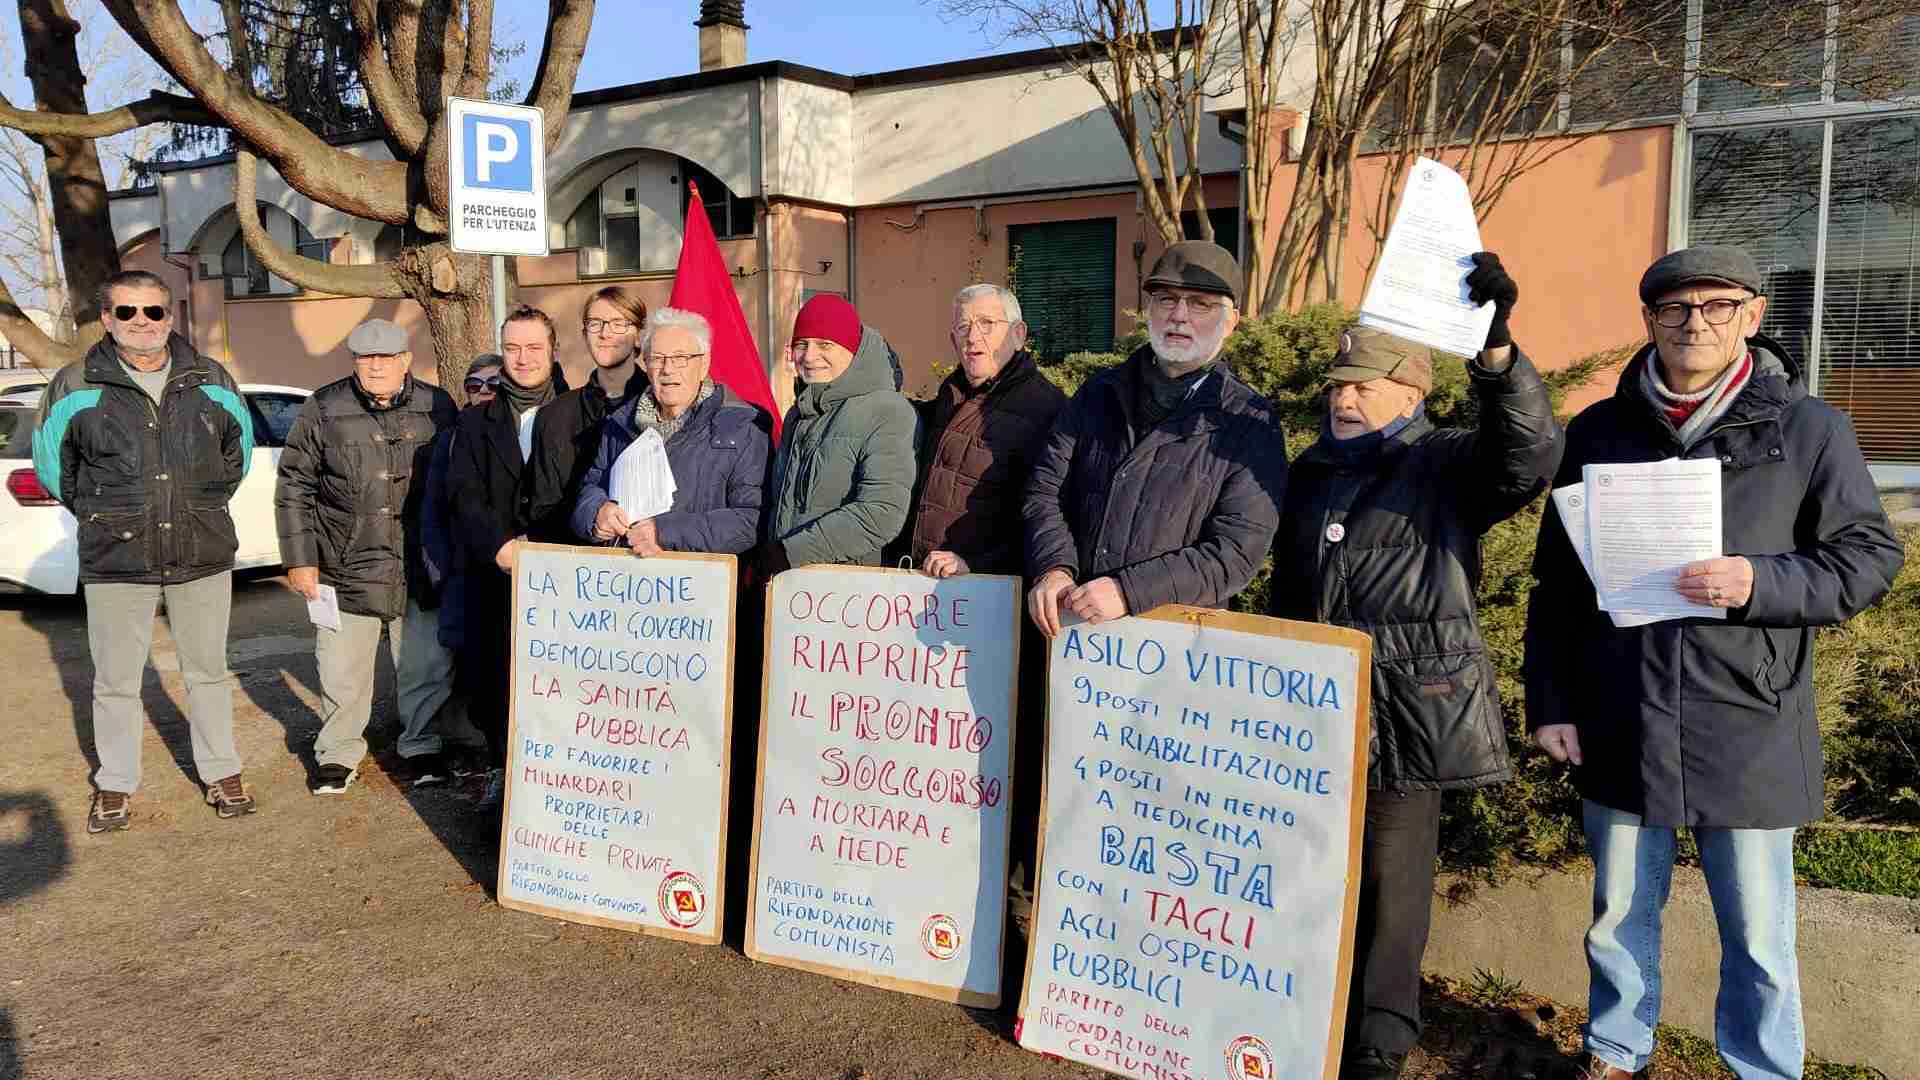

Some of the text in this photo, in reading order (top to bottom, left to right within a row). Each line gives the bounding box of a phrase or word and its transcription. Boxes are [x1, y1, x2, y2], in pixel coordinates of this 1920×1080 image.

[476, 121, 518, 182] P
[463, 204, 537, 218] PARCHEGGIO
[463, 217, 537, 231] PER L'UTENZA
[528, 566, 696, 605] LA REGIONE
[526, 607, 713, 643] E I VARI GOVERNI
[789, 590, 969, 632] OCCORRE
[529, 639, 707, 682] DEMOLISCONO
[793, 635, 976, 689] RIAPRIRE
[1063, 629, 1341, 709] ASILO VITTORIA
[531, 674, 677, 715] LA SANITÀ
[1074, 675, 1314, 752] 9 POSTI IN MENO
[575, 711, 690, 751] PUBBLICA
[791, 690, 993, 754] IL PRONTO
[524, 739, 554, 760] PER
[567, 747, 652, 775] FAVORIRE
[821, 746, 1001, 809] SOCCORSO
[1093, 721, 1332, 796] A RIABILITAZIONE
[523, 766, 633, 801] MILIARDARI
[1074, 756, 1296, 827] 4 POSTI IN MENO
[544, 795, 650, 826] PROPRIETARI
[563, 820, 609, 840] DELLE
[778, 795, 952, 844] A MORTARA E
[1096, 789, 1263, 851] A MEDICINA
[513, 826, 672, 874] CLINICHE PRIVATE
[810, 834, 910, 870] A MEDE
[1100, 825, 1274, 909] BASTA
[511, 874, 588, 905] RIFONDAZIONE
[767, 876, 873, 908] PARTITO DELLA
[1057, 869, 1255, 951] CON I TAGLI
[768, 897, 896, 936] RIFONDAZIONE
[773, 922, 896, 966] COMUNISTA
[1060, 907, 1293, 997] AGLI OSPEDALI
[1052, 942, 1182, 1008] PUBBLICI
[1047, 982, 1191, 1040] PARTITO DELLA
[1039, 1006, 1192, 1070] RIFONDAZIONE
[1068, 1039, 1211, 1080] COMUNIST
